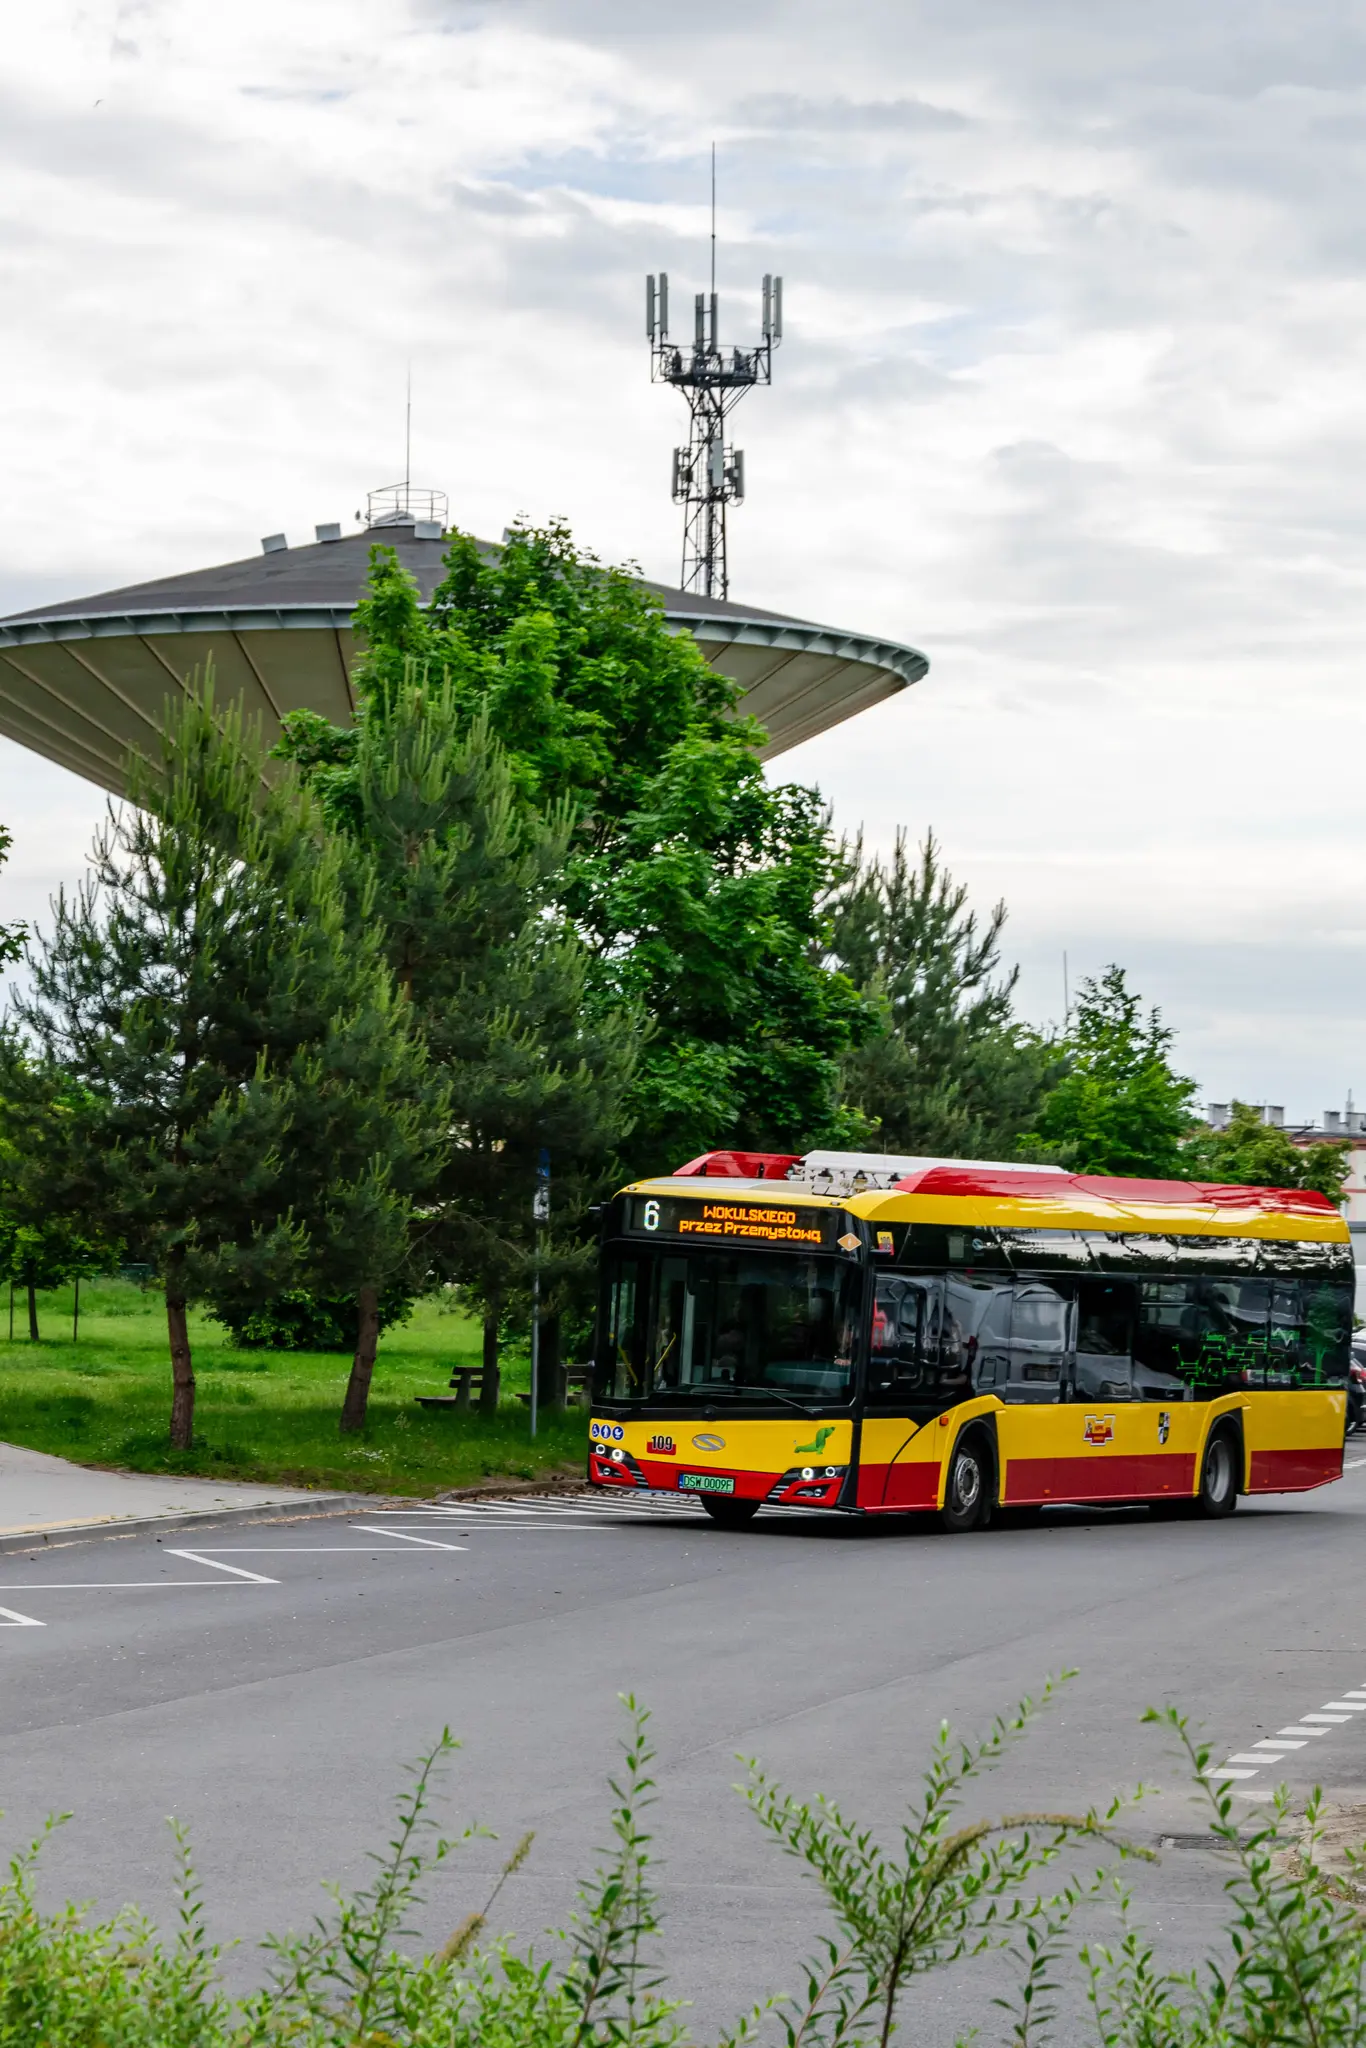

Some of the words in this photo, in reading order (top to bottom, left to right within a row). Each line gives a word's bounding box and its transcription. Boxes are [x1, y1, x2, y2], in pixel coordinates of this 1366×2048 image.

[643, 1200, 660, 1230] 6
[703, 1205, 796, 1224] WOKULSKIEGO
[679, 1218, 722, 1234] przez
[724, 1223, 821, 1243] Przemysłową
[651, 1435, 673, 1451] 109
[683, 1475, 702, 1487] DSW
[704, 1478, 733, 1490] 0009F
